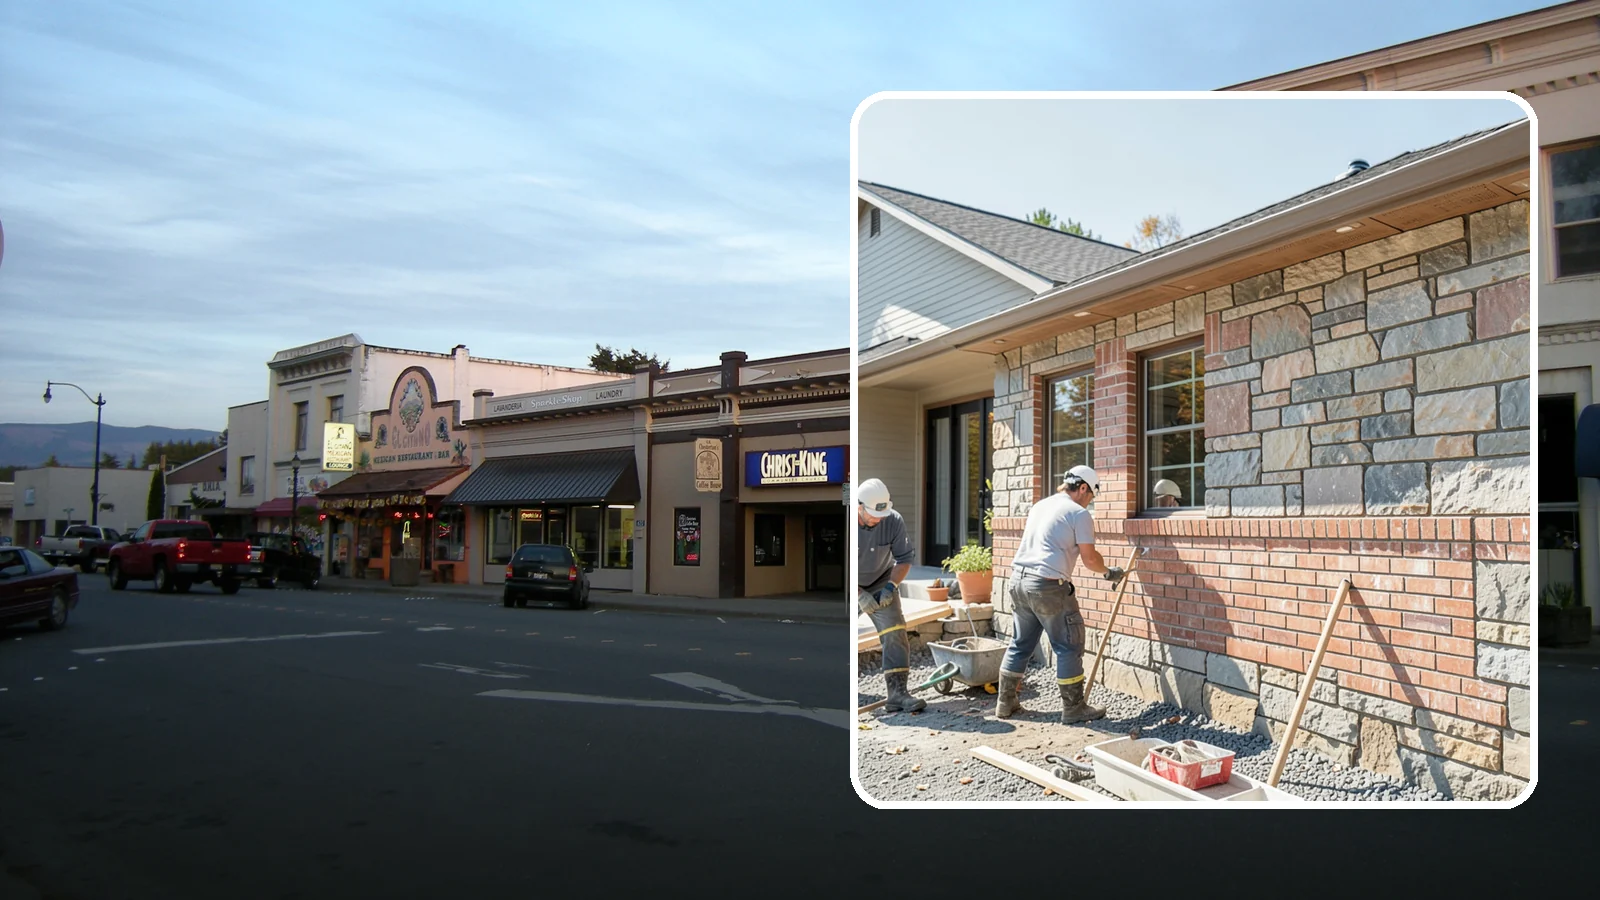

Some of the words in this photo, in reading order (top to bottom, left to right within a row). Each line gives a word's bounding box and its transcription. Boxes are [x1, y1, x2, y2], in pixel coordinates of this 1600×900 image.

[494, 402, 522, 413] LAVANDERIA
[595, 389, 623, 400] LAUNDRY
[397, 451, 433, 462] RESTAURANT
[438, 450, 450, 459] BAR
[799, 450, 827, 476] KING
[696, 480, 709, 488] Coffee
[710, 480, 722, 489] House
